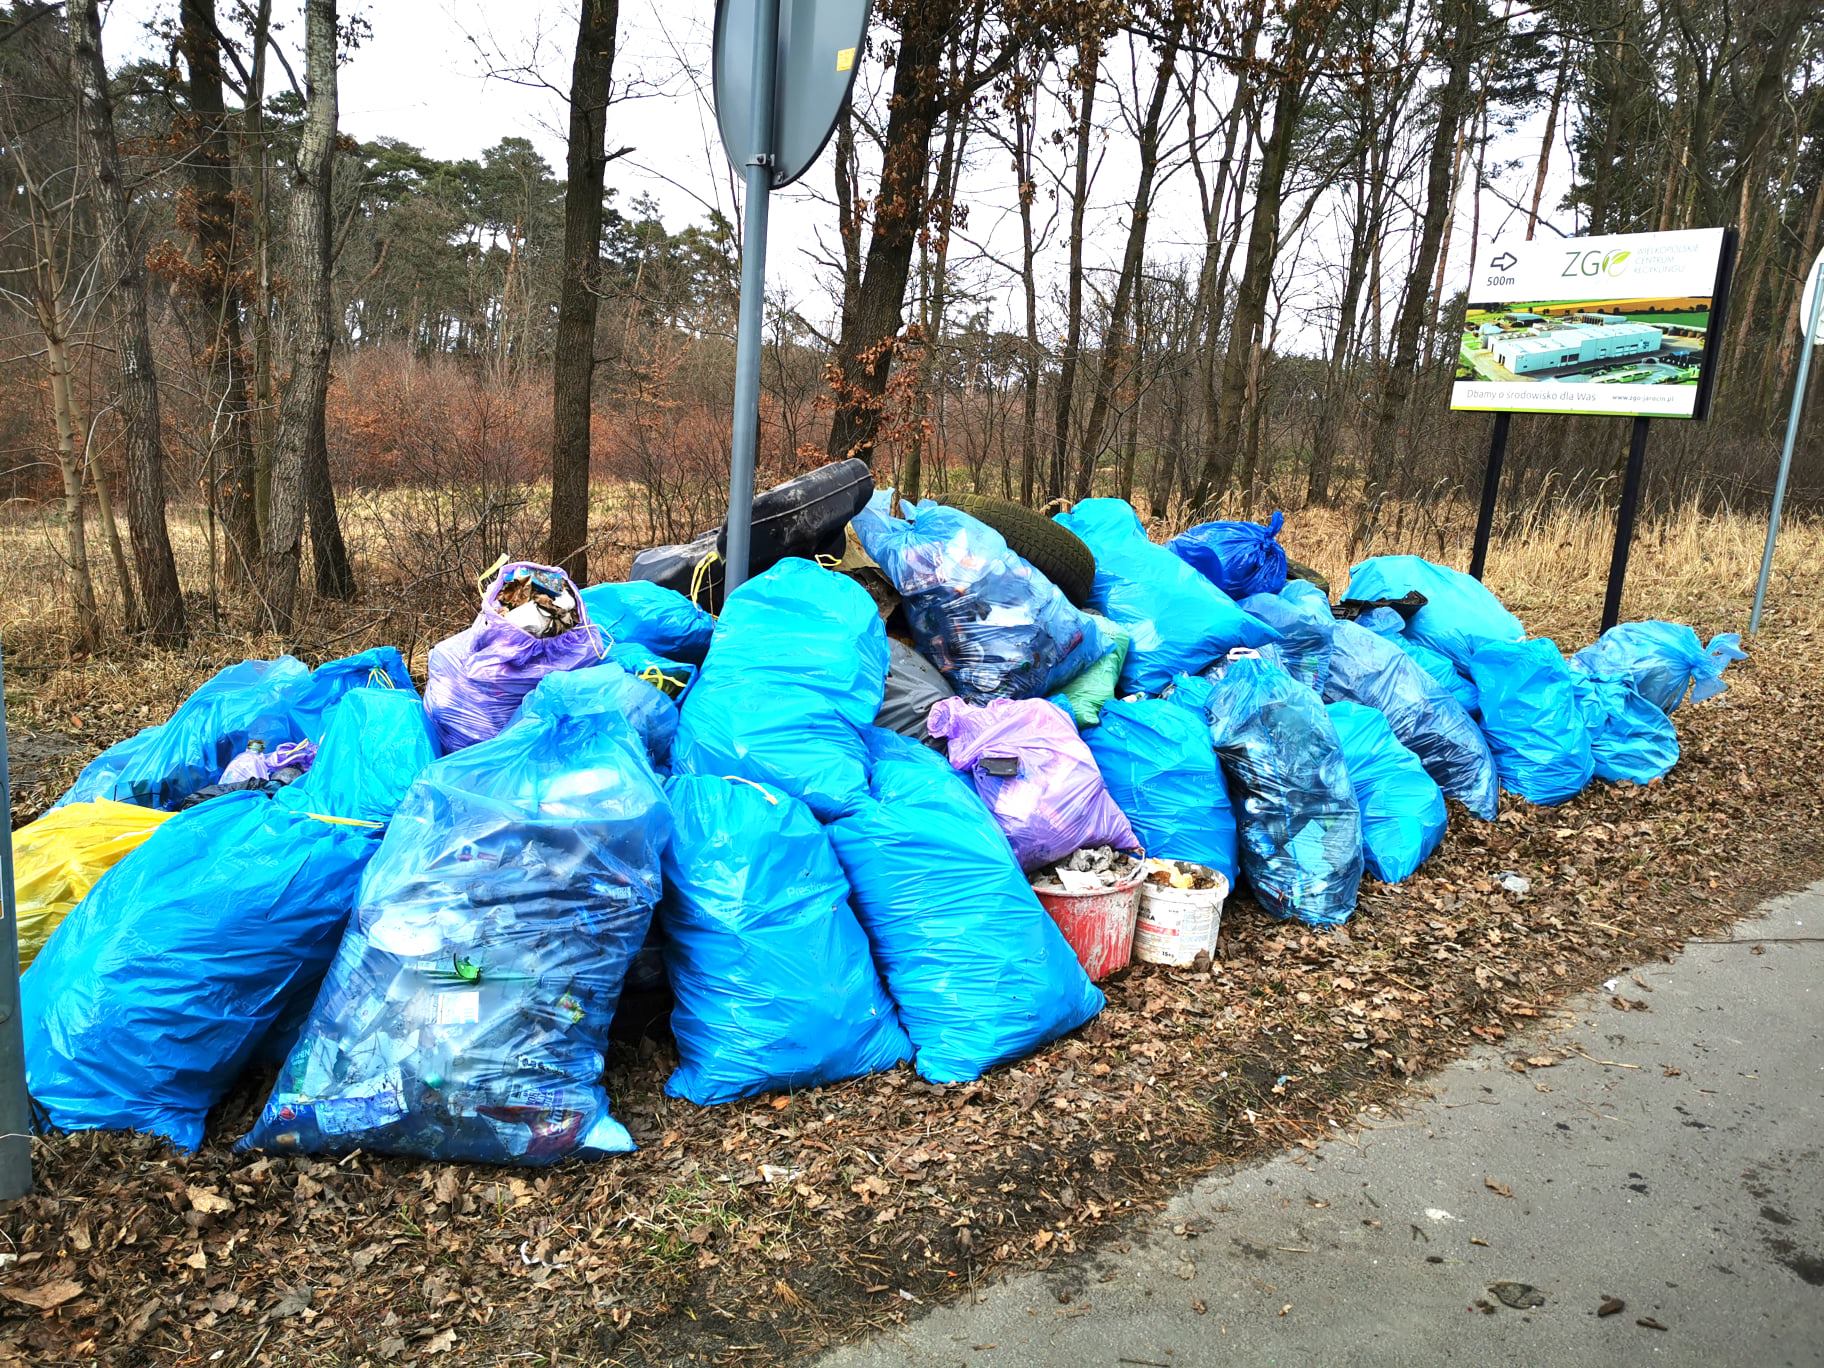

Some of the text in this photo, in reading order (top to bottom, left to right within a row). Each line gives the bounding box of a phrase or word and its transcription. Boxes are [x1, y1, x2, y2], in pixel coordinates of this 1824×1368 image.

[1486, 275, 1515, 287] 500m
[1467, 389, 1496, 400] Dbamy
[1560, 391, 1574, 401] dla
[1577, 391, 1596, 402] Was
